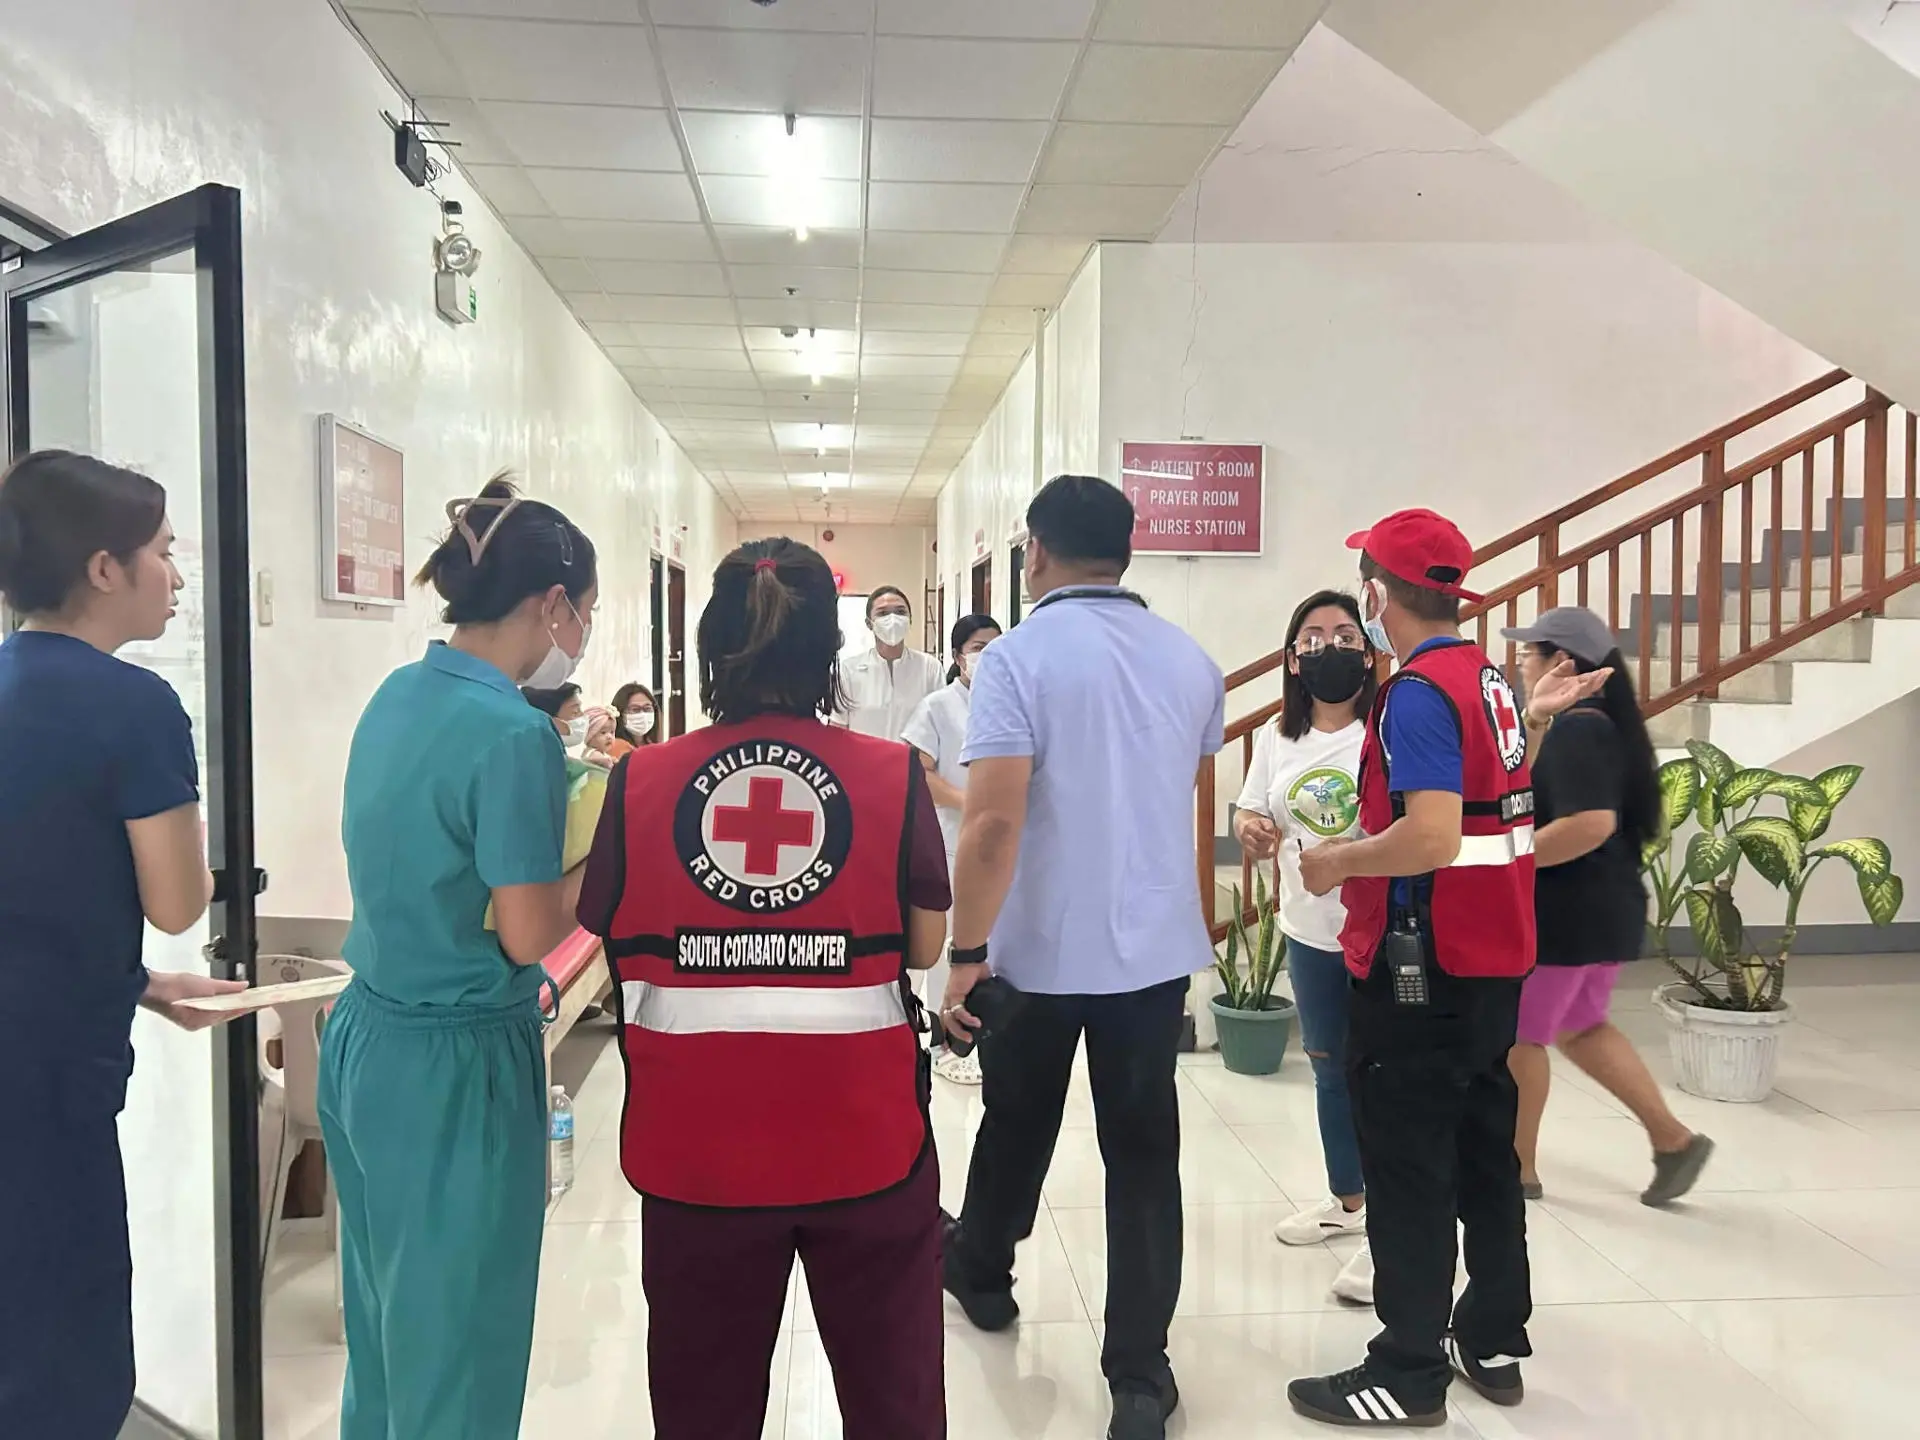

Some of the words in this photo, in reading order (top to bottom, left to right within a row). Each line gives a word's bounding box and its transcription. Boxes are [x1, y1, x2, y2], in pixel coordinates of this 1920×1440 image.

[1150, 460, 1214, 477] PATIENT'S
[1218, 462, 1254, 478] ROOM
[1150, 489, 1198, 506] PRAYER
[1202, 491, 1239, 507] ROOM
[1150, 519, 1191, 535] NURSE
[1195, 520, 1246, 536] STATION
[1503, 736, 1526, 770] ROSS
[693, 744, 838, 801] PHILIPPINE
[689, 853, 738, 901] RED
[749, 859, 833, 909] CROSS
[678, 934, 721, 967] SOUTH
[723, 934, 786, 967] COTABATO
[788, 935, 847, 967] CHAPTER
